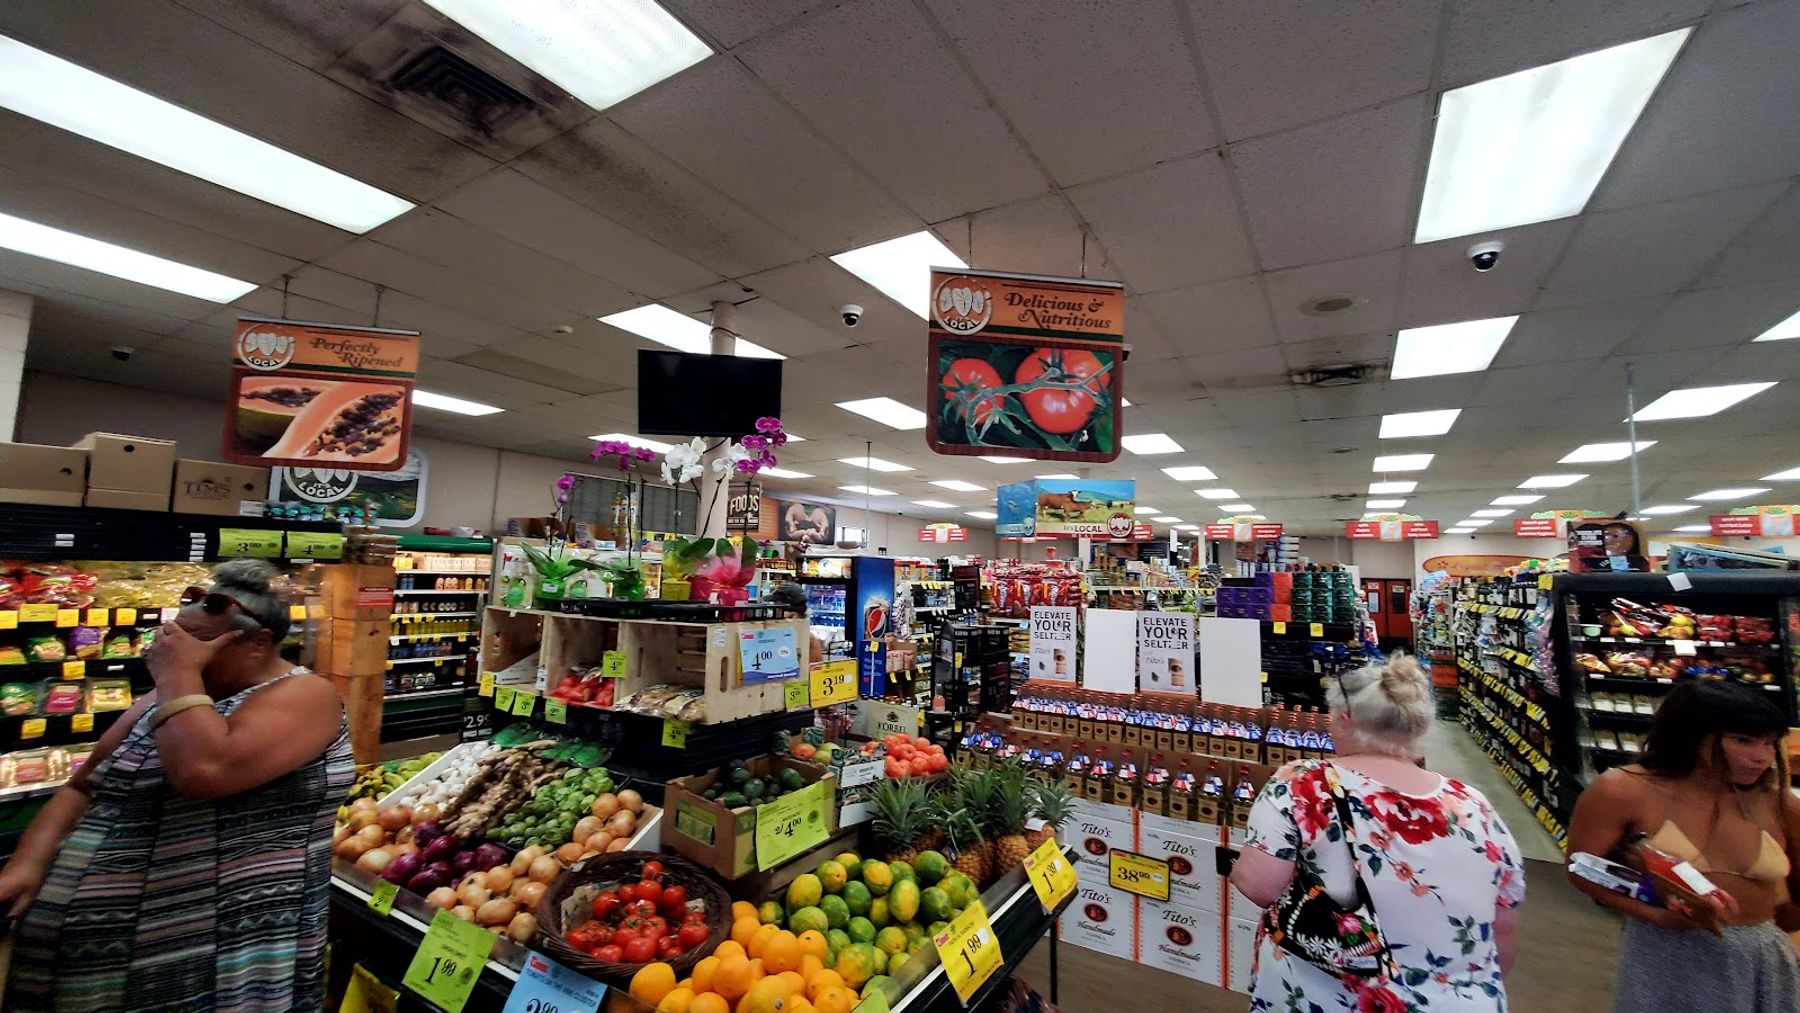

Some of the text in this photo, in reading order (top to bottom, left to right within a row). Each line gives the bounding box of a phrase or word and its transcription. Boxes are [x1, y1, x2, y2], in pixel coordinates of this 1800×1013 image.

[1004, 291, 1104, 313] Delicious &
[944, 316, 980, 330] LOCAL
[1017, 309, 1112, 330] Nutritious
[309, 337, 381, 355] Perfectly
[248, 355, 282, 366] LOCAL
[338, 353, 404, 368] Ripened
[298, 481, 344, 498] LOCAL
[1075, 525, 1103, 533] LOCAL
[1034, 611, 1071, 620] ELEVATE
[1143, 617, 1187, 627] ELEVATE
[1034, 619, 1071, 632] YOUR
[1143, 626, 1188, 640] YOUR
[1081, 822, 1112, 838] Tito's
[1162, 840, 1197, 857] Tito's
[1081, 888, 1112, 904] Tito's
[1162, 909, 1197, 928] Tito's
[1077, 920, 1116, 937] Handmade
[1159, 943, 1201, 961] Handmade
